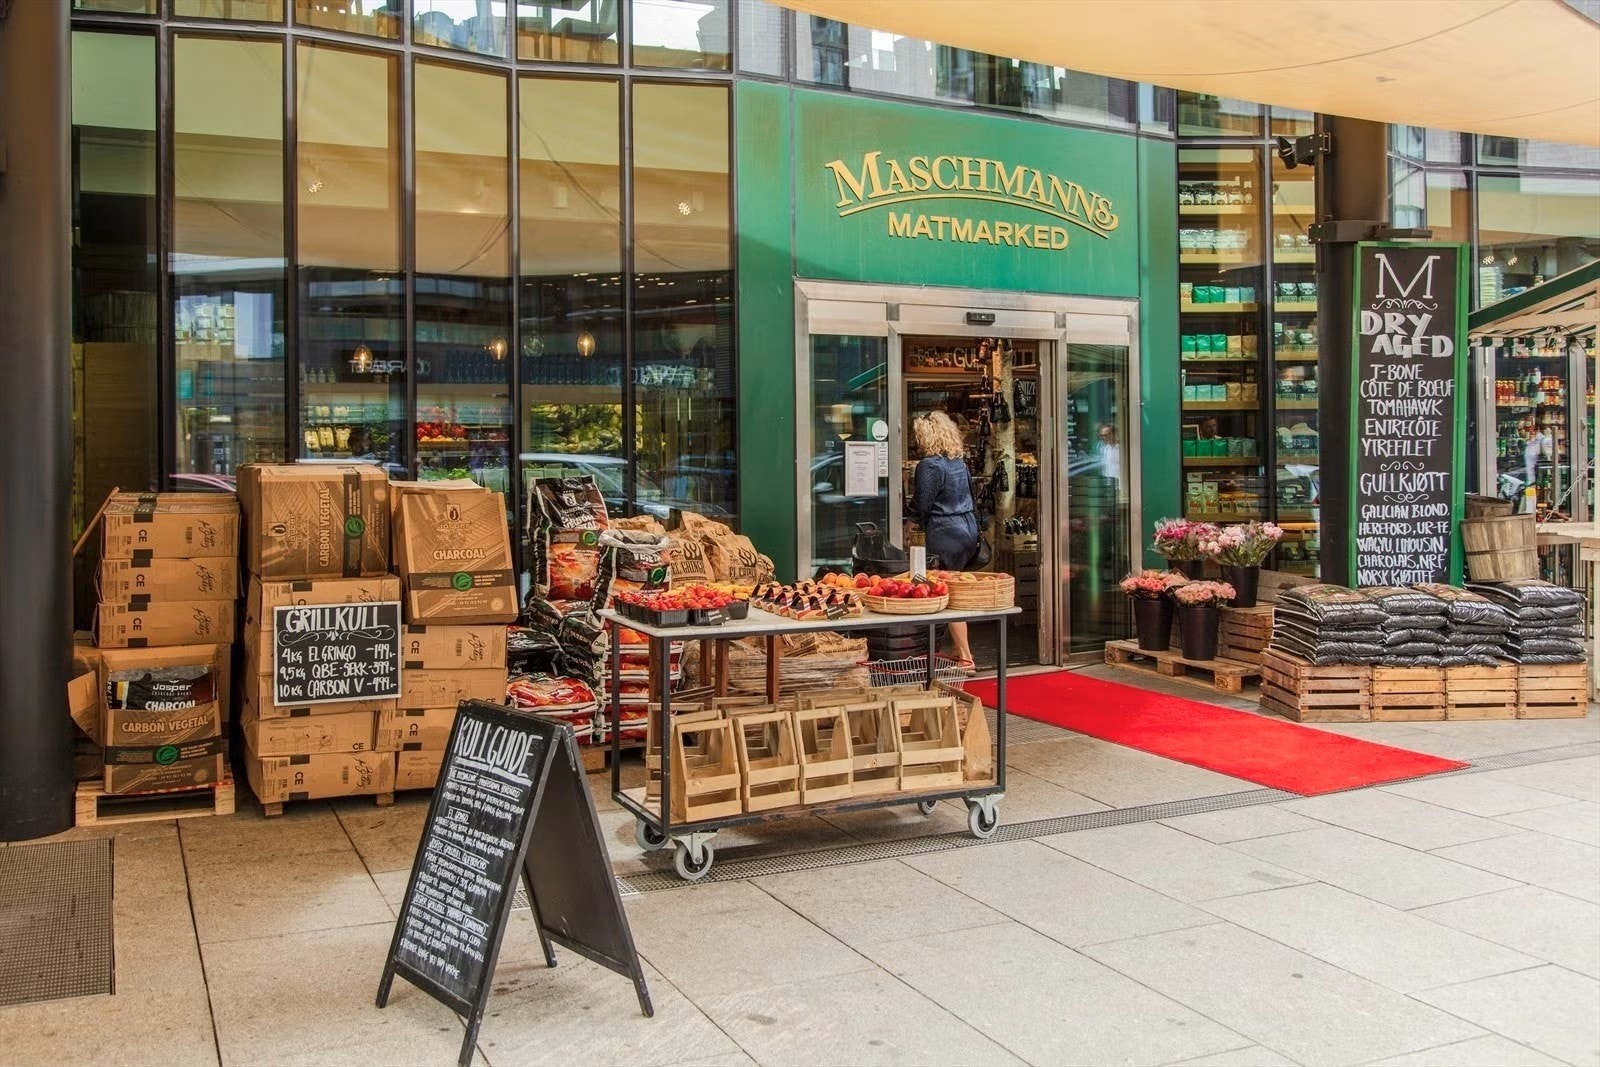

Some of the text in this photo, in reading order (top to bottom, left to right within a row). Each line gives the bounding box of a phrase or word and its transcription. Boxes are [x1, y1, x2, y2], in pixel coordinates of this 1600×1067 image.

[888, 212, 1069, 250] MATMARKED
[1374, 253, 1440, 299] M
[1360, 310, 1432, 337] DRY
[1371, 334, 1454, 358] AGED
[1370, 363, 1424, 380] T-BONE
[1360, 378, 1394, 398] CÔTE
[1398, 381, 1414, 398] DE
[1366, 398, 1443, 417] TOMAHAWK
[1365, 416, 1442, 438] ENTRECÔTE
[1361, 437, 1437, 457] YTREFILET
[1360, 471, 1450, 496] GULLKJØTT
[319, 487, 330, 527] VEGETAL
[1361, 503, 1409, 521] GALICIAN
[433, 548, 486, 560] CHARCOAL
[1357, 570, 1389, 586] NORSK
[285, 606, 390, 633] GRILLKULL
[321, 645, 356, 661] GRINGO
[152, 683, 193, 692] Josper
[307, 680, 350, 698] CARBON
[354, 677, 364, 693] V
[145, 700, 197, 712] CHARCOAL
[121, 716, 208, 733] CARBÓN VEGETAL
[453, 716, 543, 778] KULLGUIDE
